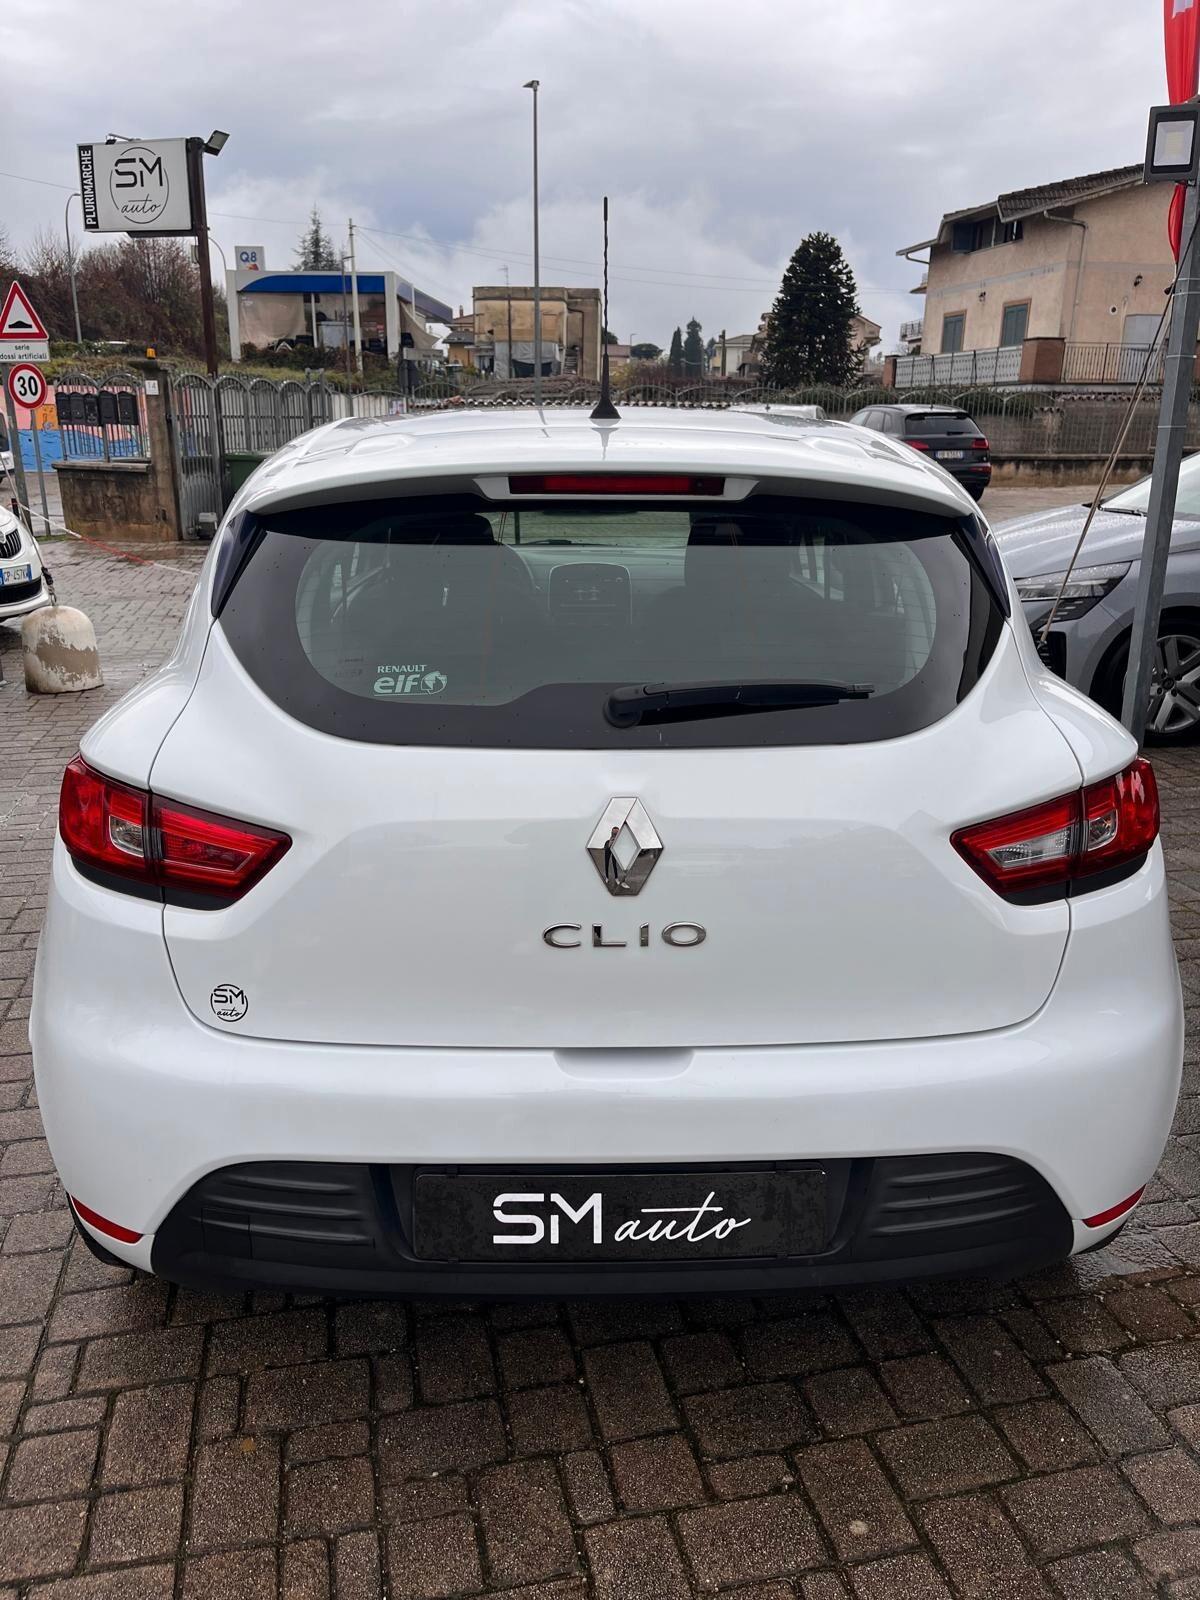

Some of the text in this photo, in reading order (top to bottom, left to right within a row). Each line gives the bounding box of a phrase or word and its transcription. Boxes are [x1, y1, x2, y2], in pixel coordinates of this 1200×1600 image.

[114, 156, 163, 188] SM
[80, 149, 97, 225] PLURIMARCHE
[121, 193, 161, 213] auto
[239, 251, 257, 262] Q8
[0, 352, 47, 360] dossi artificiali
[14, 343, 30, 351] serie
[17, 375, 38, 397] 30
[377, 664, 427, 674] RENAULT
[373, 674, 420, 694] elf
[542, 921, 707, 948] CLIO
[213, 988, 245, 1005] SM
[216, 1006, 243, 1018] auto
[493, 1191, 751, 1244] SM auto
